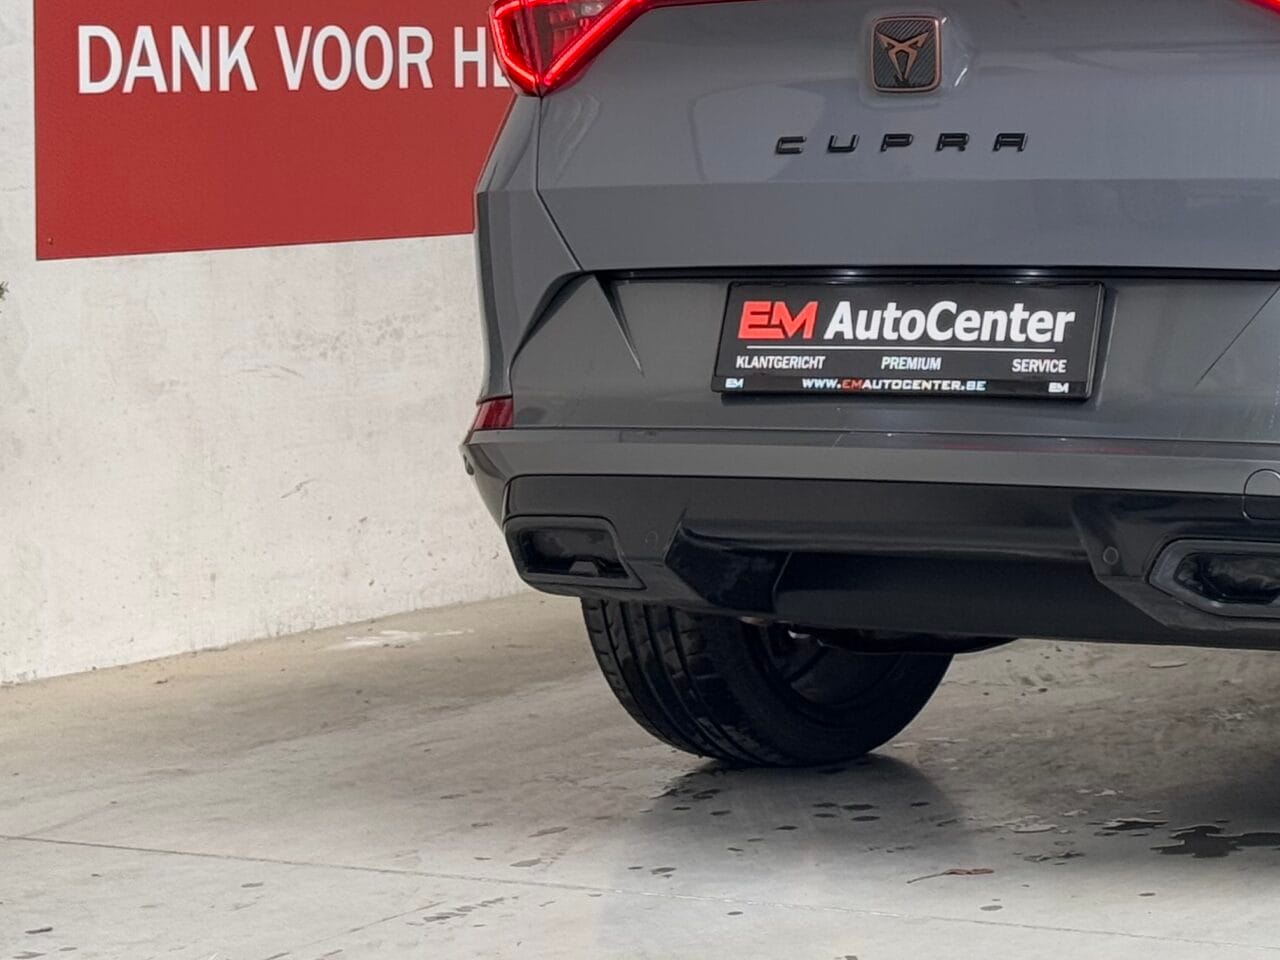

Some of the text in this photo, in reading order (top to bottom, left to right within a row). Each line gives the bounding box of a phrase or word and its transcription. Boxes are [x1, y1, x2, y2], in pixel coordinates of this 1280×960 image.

[77, 24, 258, 94] DANK
[274, 24, 434, 92] VOOR
[775, 133, 1029, 155] CUPRA
[737, 300, 1075, 343] EM AutoCenter
[735, 355, 1067, 373] KLANTGERICHT PREMIUM SERVICE
[802, 378, 987, 392] WWW.EMAUTOCENTER.BE
